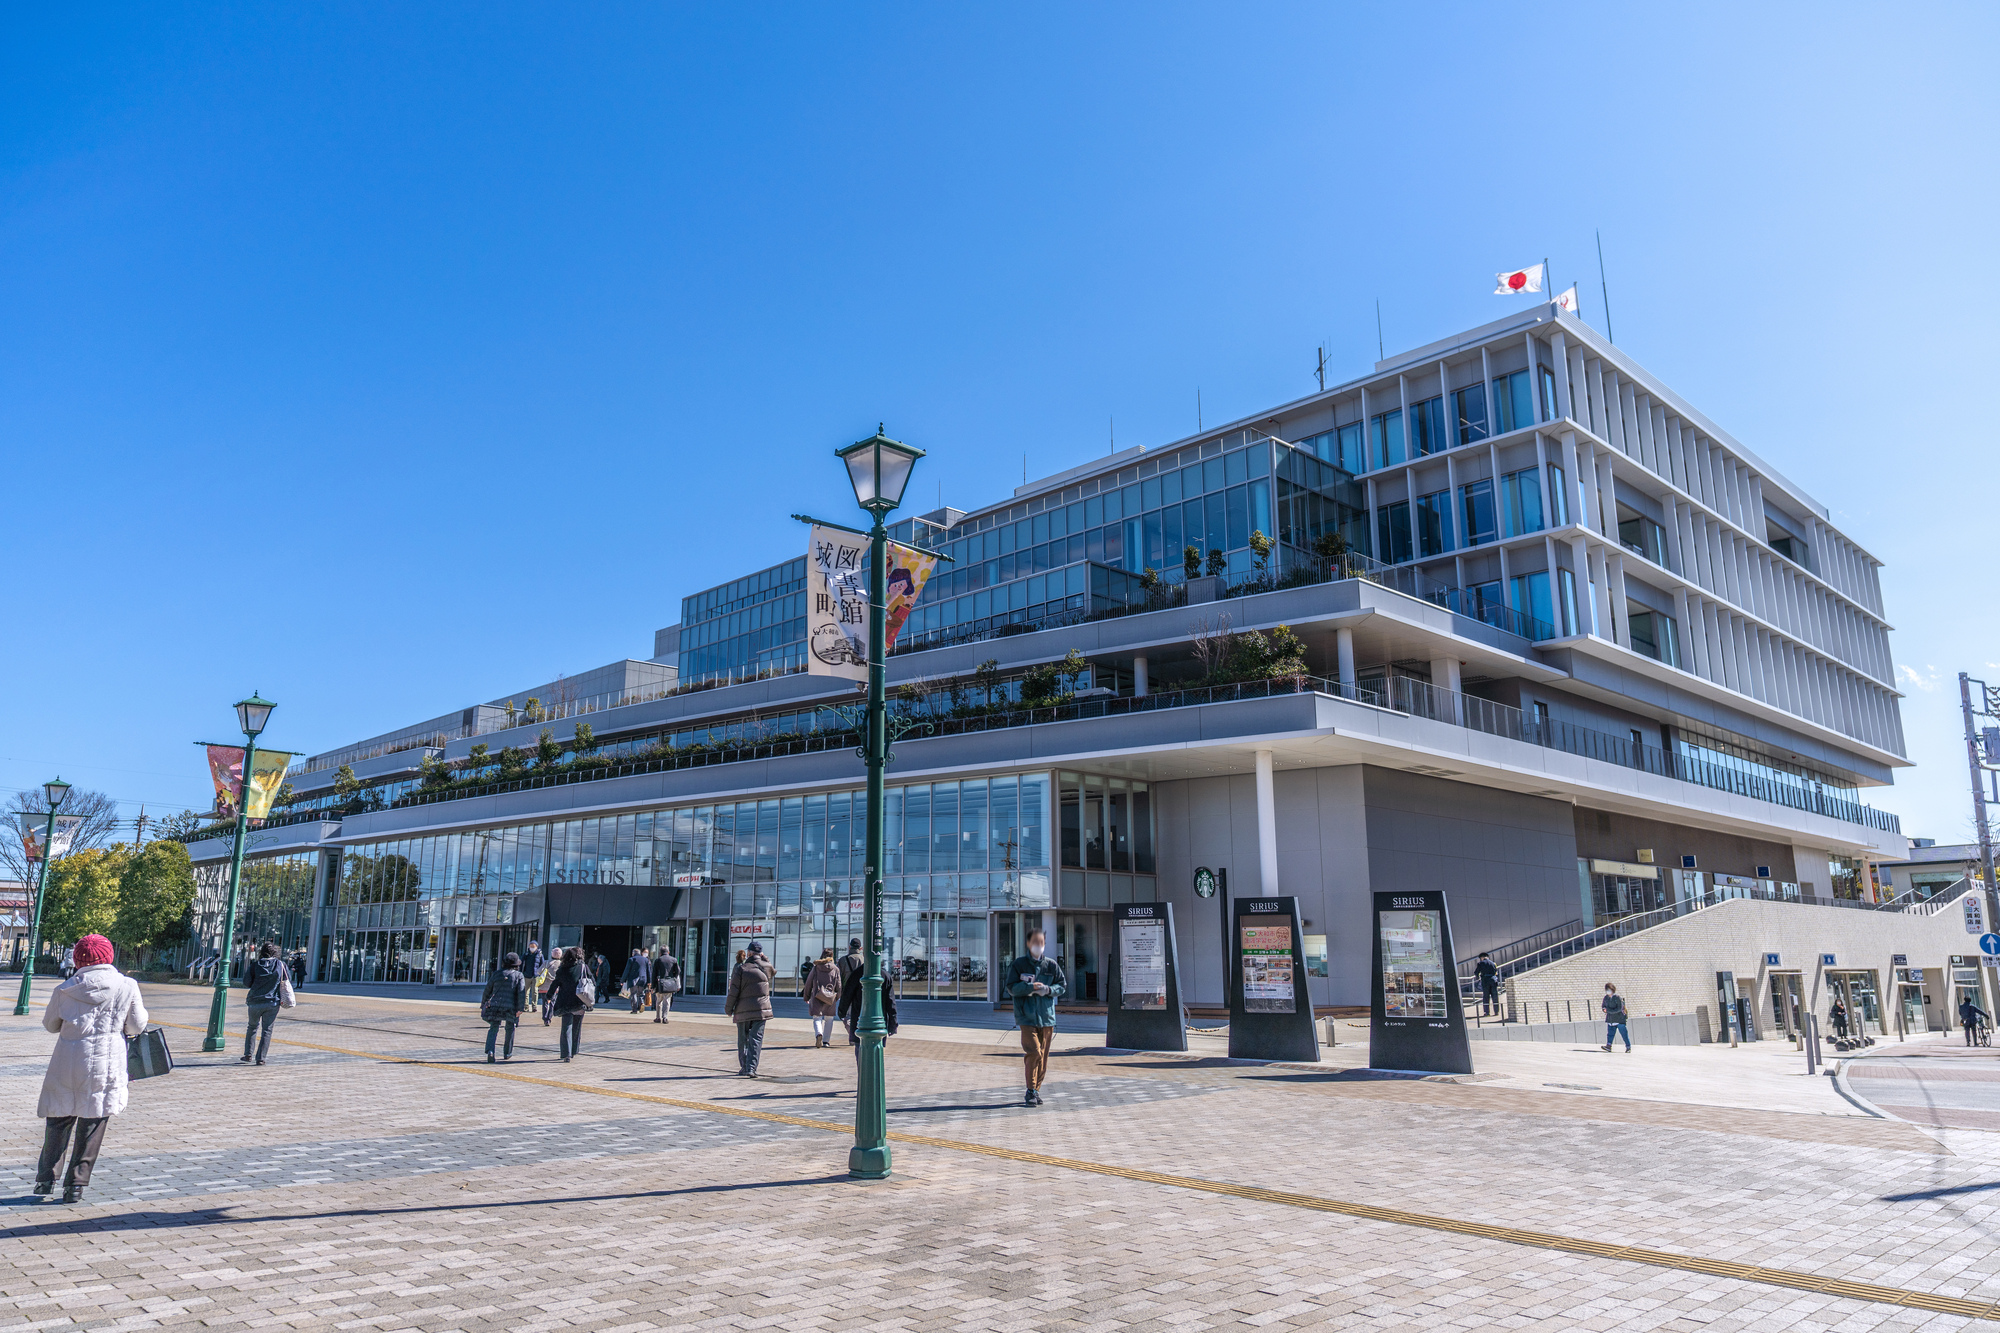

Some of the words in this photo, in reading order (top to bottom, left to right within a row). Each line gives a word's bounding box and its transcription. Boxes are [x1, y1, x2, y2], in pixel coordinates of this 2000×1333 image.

[815, 541, 837, 617] 城下町
[834, 544, 862, 624] 図書館
